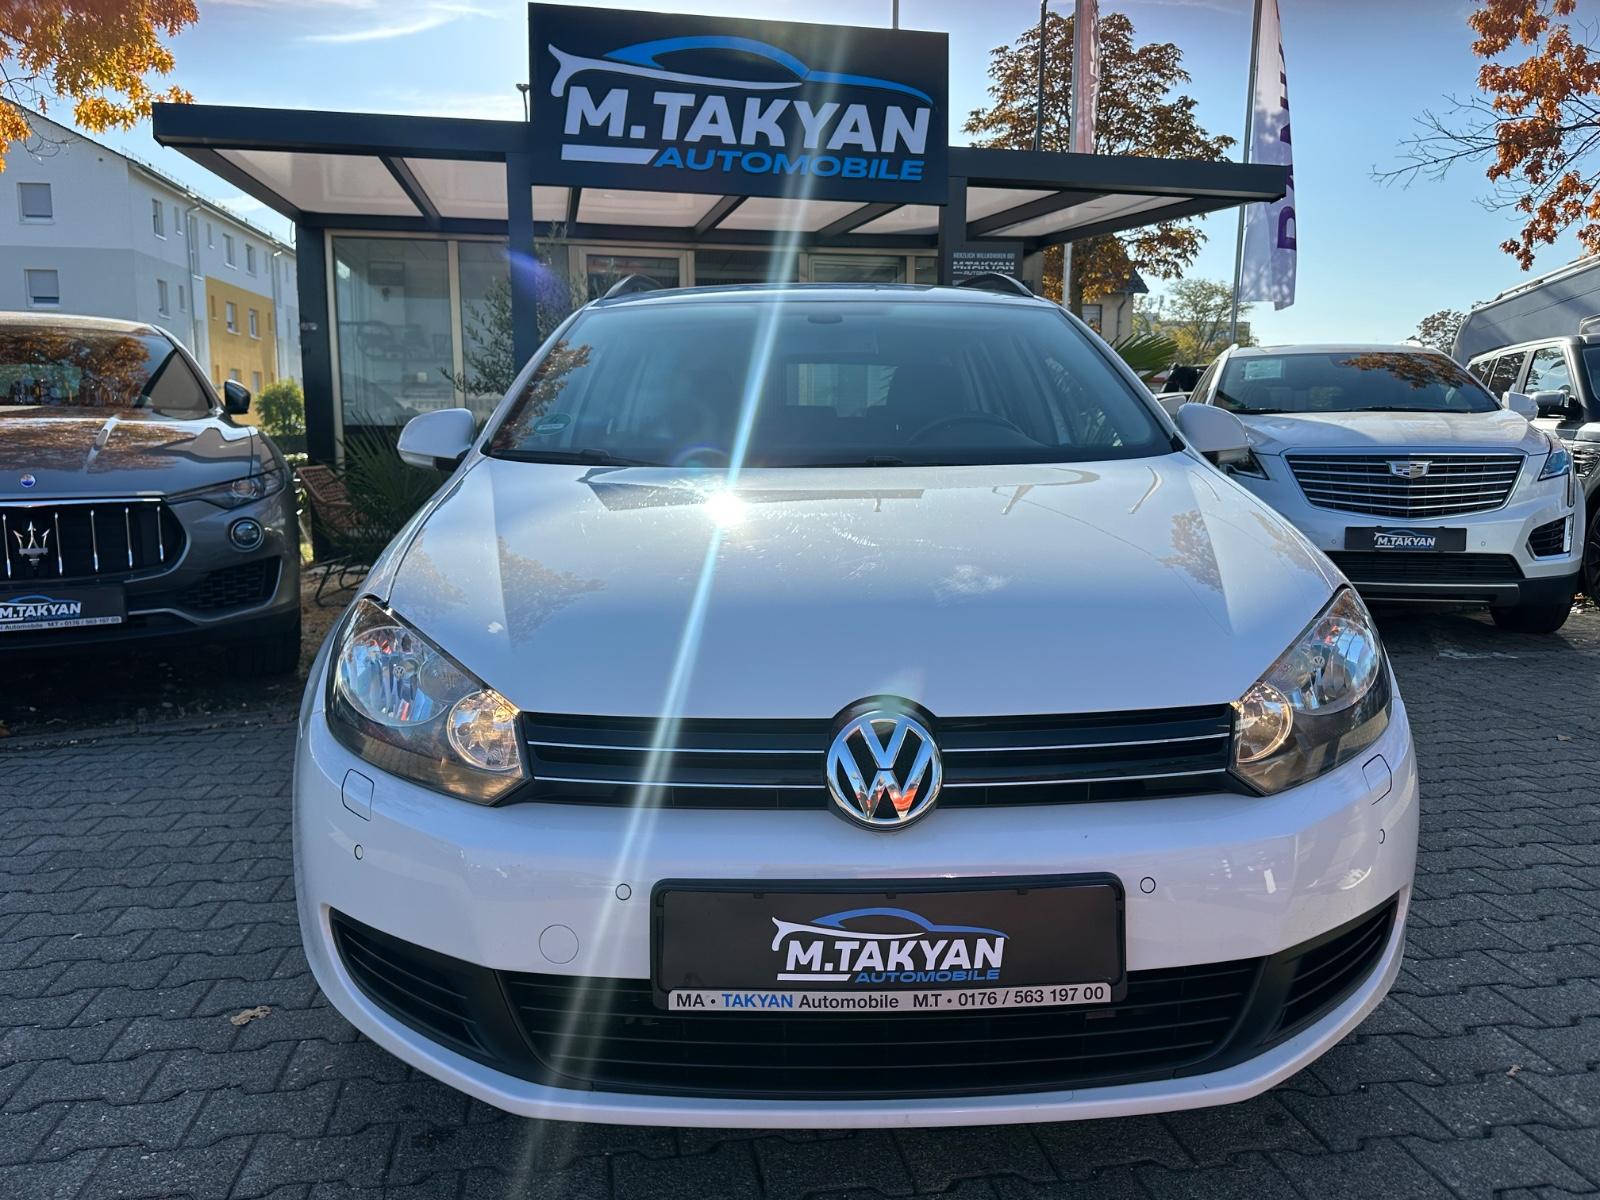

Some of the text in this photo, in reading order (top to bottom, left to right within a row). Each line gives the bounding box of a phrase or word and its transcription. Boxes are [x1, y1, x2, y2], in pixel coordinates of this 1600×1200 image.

[564, 86, 931, 154] M.TAKYAN
[653, 147, 925, 181] AUTOMOBILE
[1377, 537, 1436, 546] M.TAKYAN
[785, 937, 1005, 971] M.TAKYAN
[855, 970, 1000, 983] AUTOMOBILE
[722, 993, 793, 1008] TAKYAN
[799, 994, 899, 1009] Automobile
[913, 993, 942, 1008] M.T
[958, 992, 997, 1007] 0176
[1014, 989, 1044, 1004] 563
[1050, 987, 1078, 1002] 197
[1083, 986, 1104, 1000] 00
